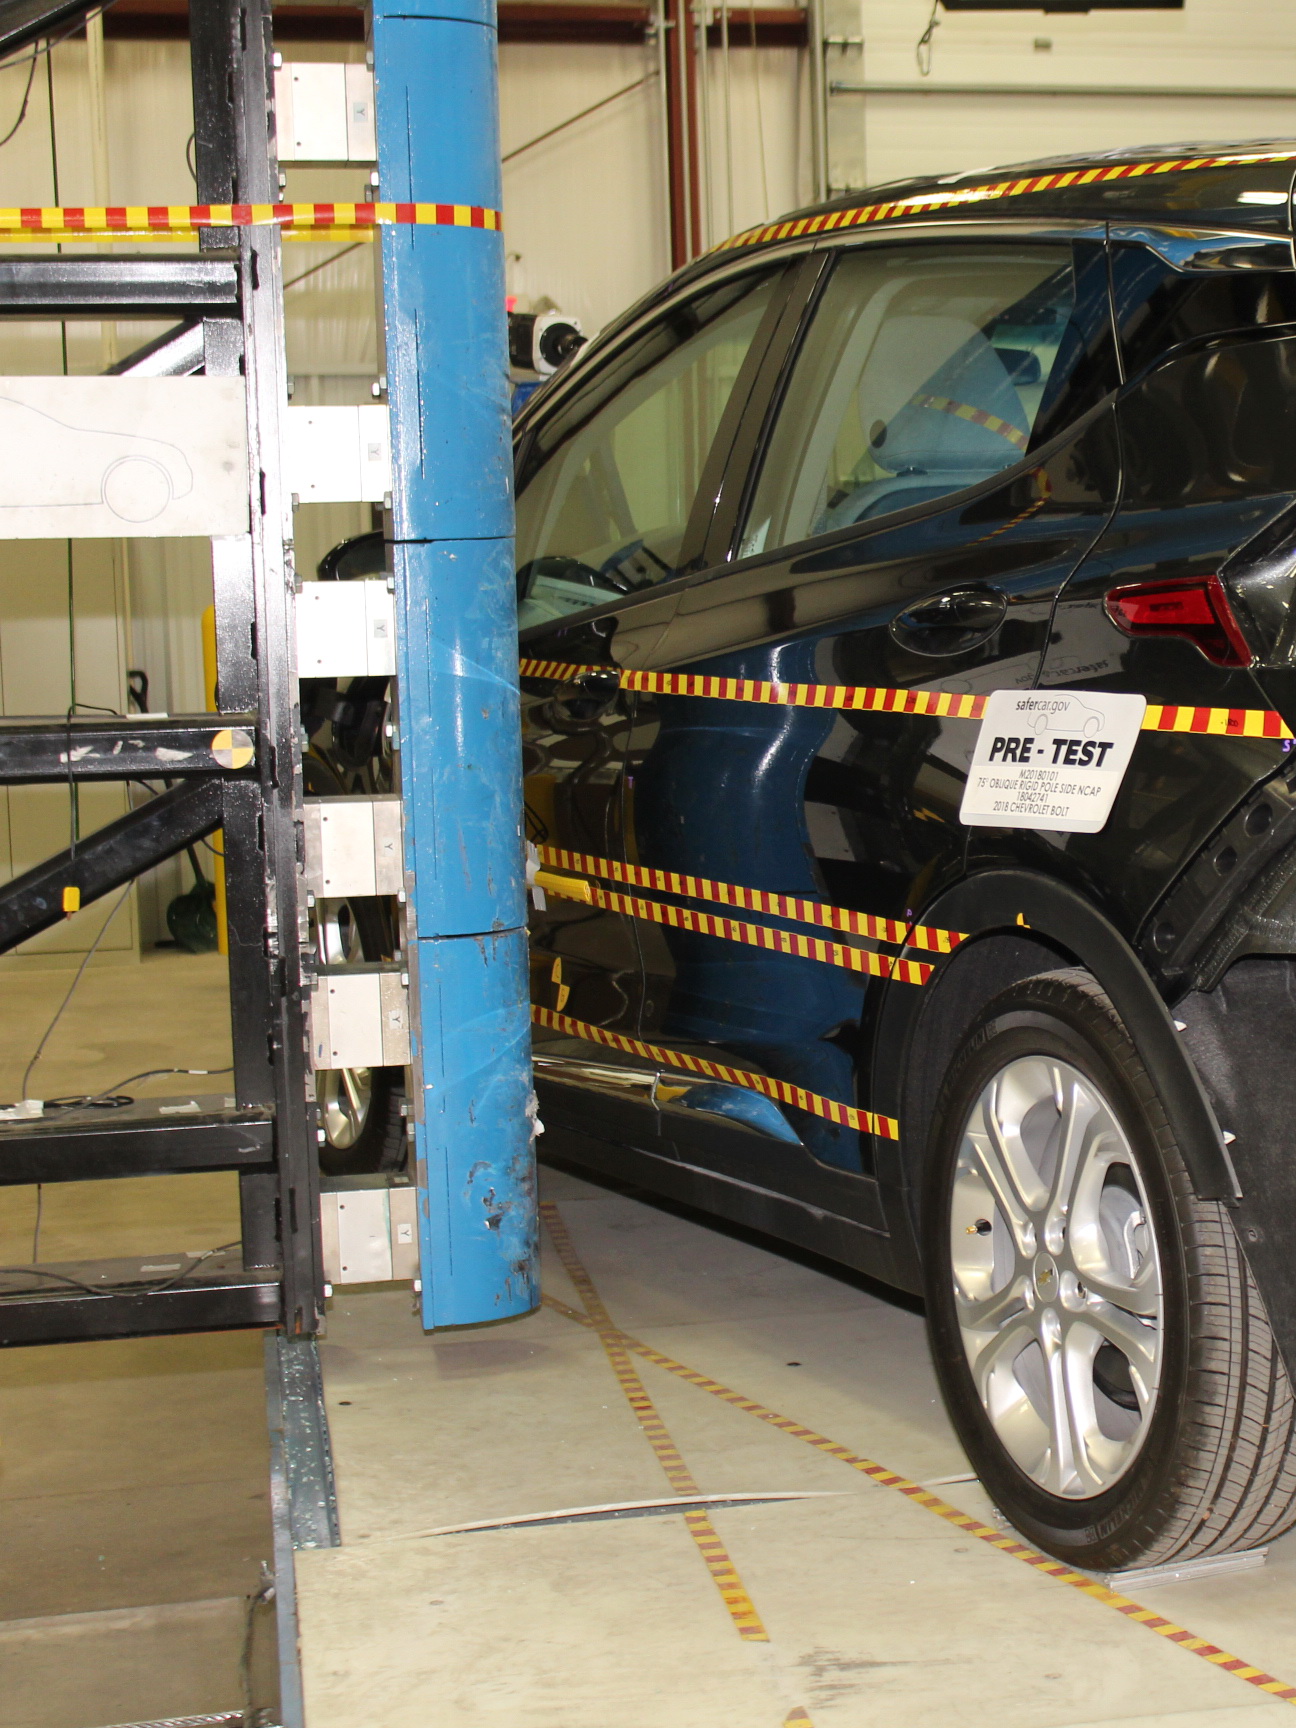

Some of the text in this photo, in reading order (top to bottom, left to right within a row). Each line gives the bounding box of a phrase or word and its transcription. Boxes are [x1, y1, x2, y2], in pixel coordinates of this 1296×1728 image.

[1016, 698, 1070, 714] safercar.gov
[989, 737, 1034, 763] PRE
[1052, 739, 1113, 767] TEST
[1020, 769, 1059, 780] M20180101
[977, 777, 1101, 796] 75° OBLIQUE RIGID POLE SIDE NCAP
[1017, 791, 1048, 802] 18042741
[993, 801, 1069, 816] 2018 CHEVROLET BOLT
